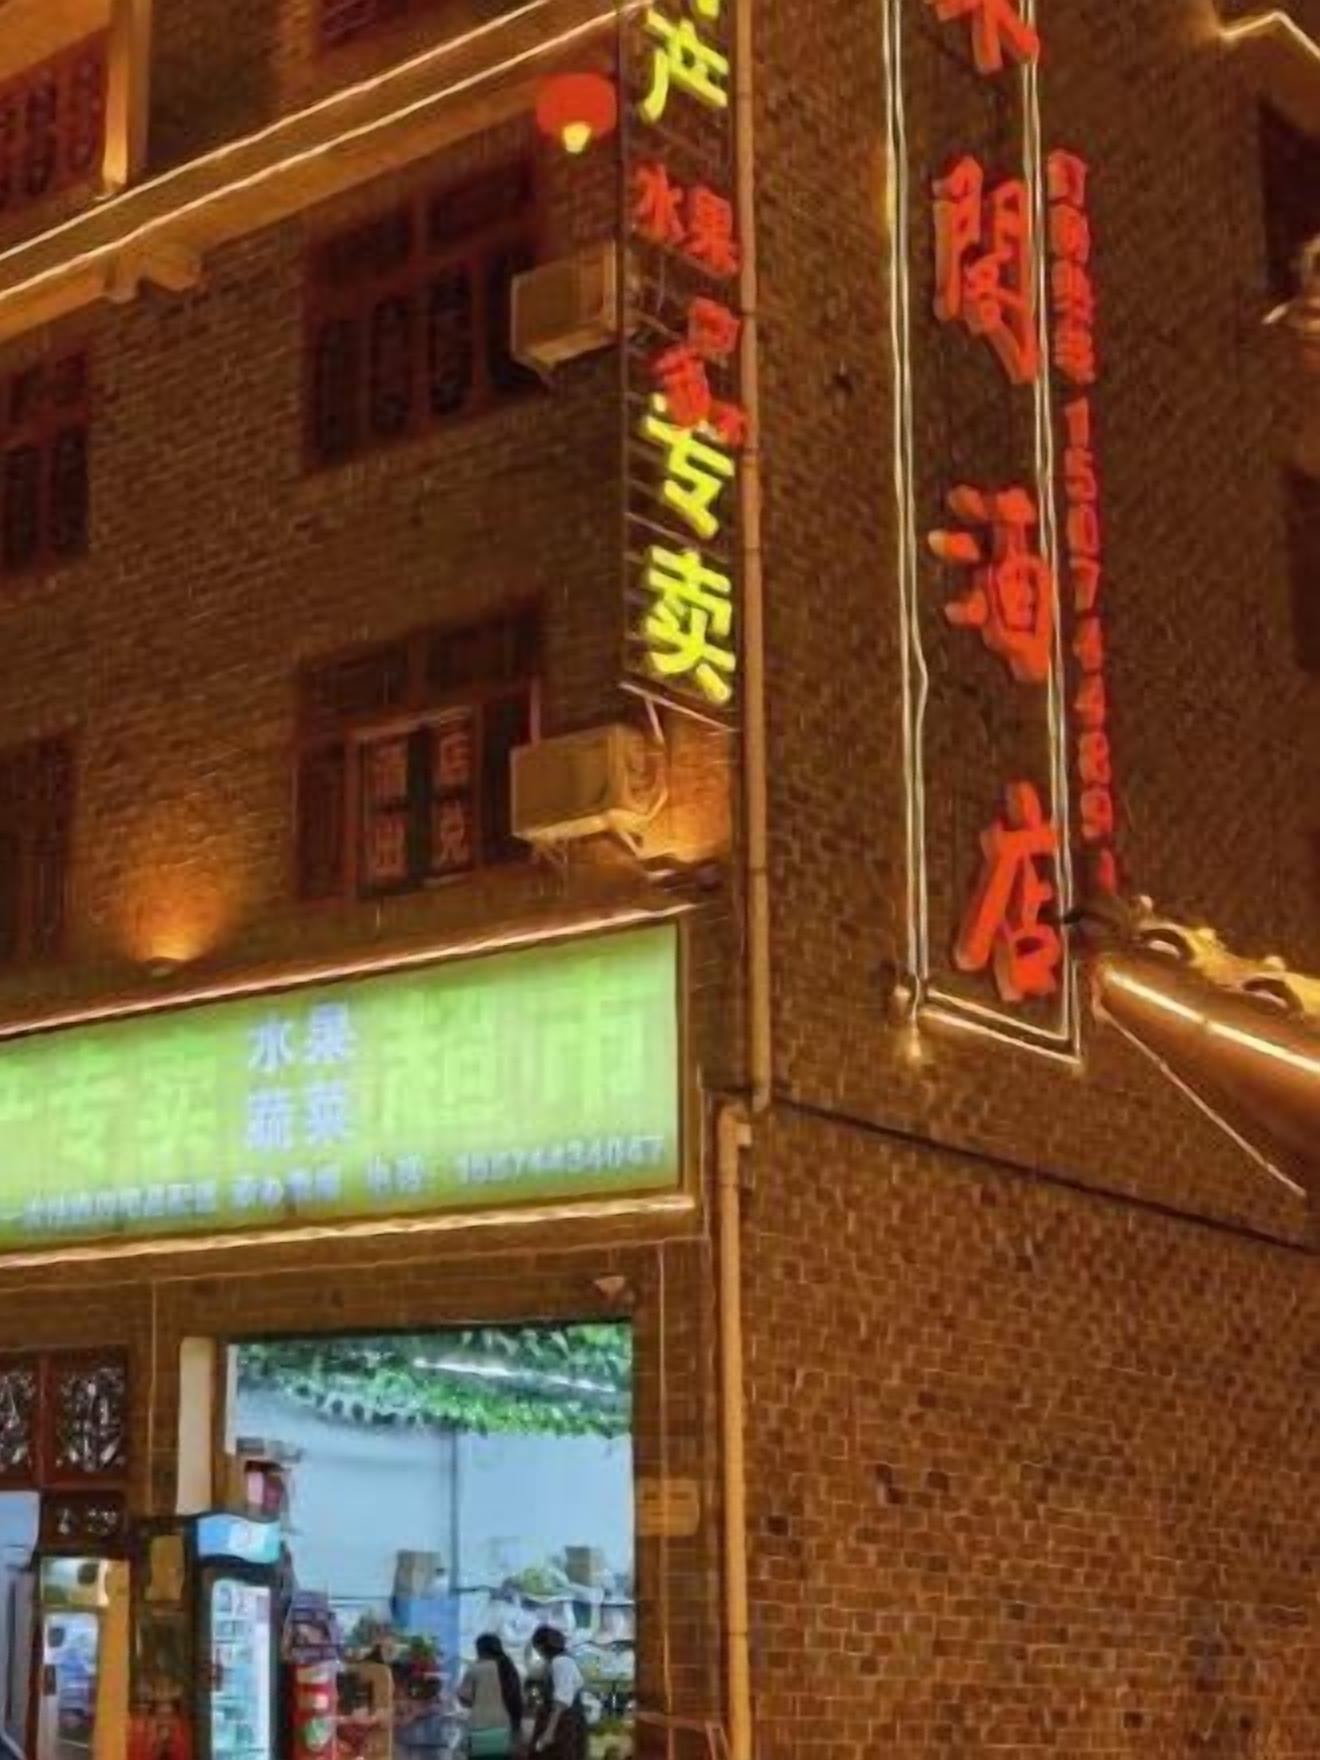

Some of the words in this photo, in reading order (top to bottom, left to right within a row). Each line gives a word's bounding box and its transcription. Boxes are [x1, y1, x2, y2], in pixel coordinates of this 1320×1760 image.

[639, 0, 729, 123] 产
[247, 1004, 355, 1071] 水果
[246, 1083, 355, 1152] 蔬菜
